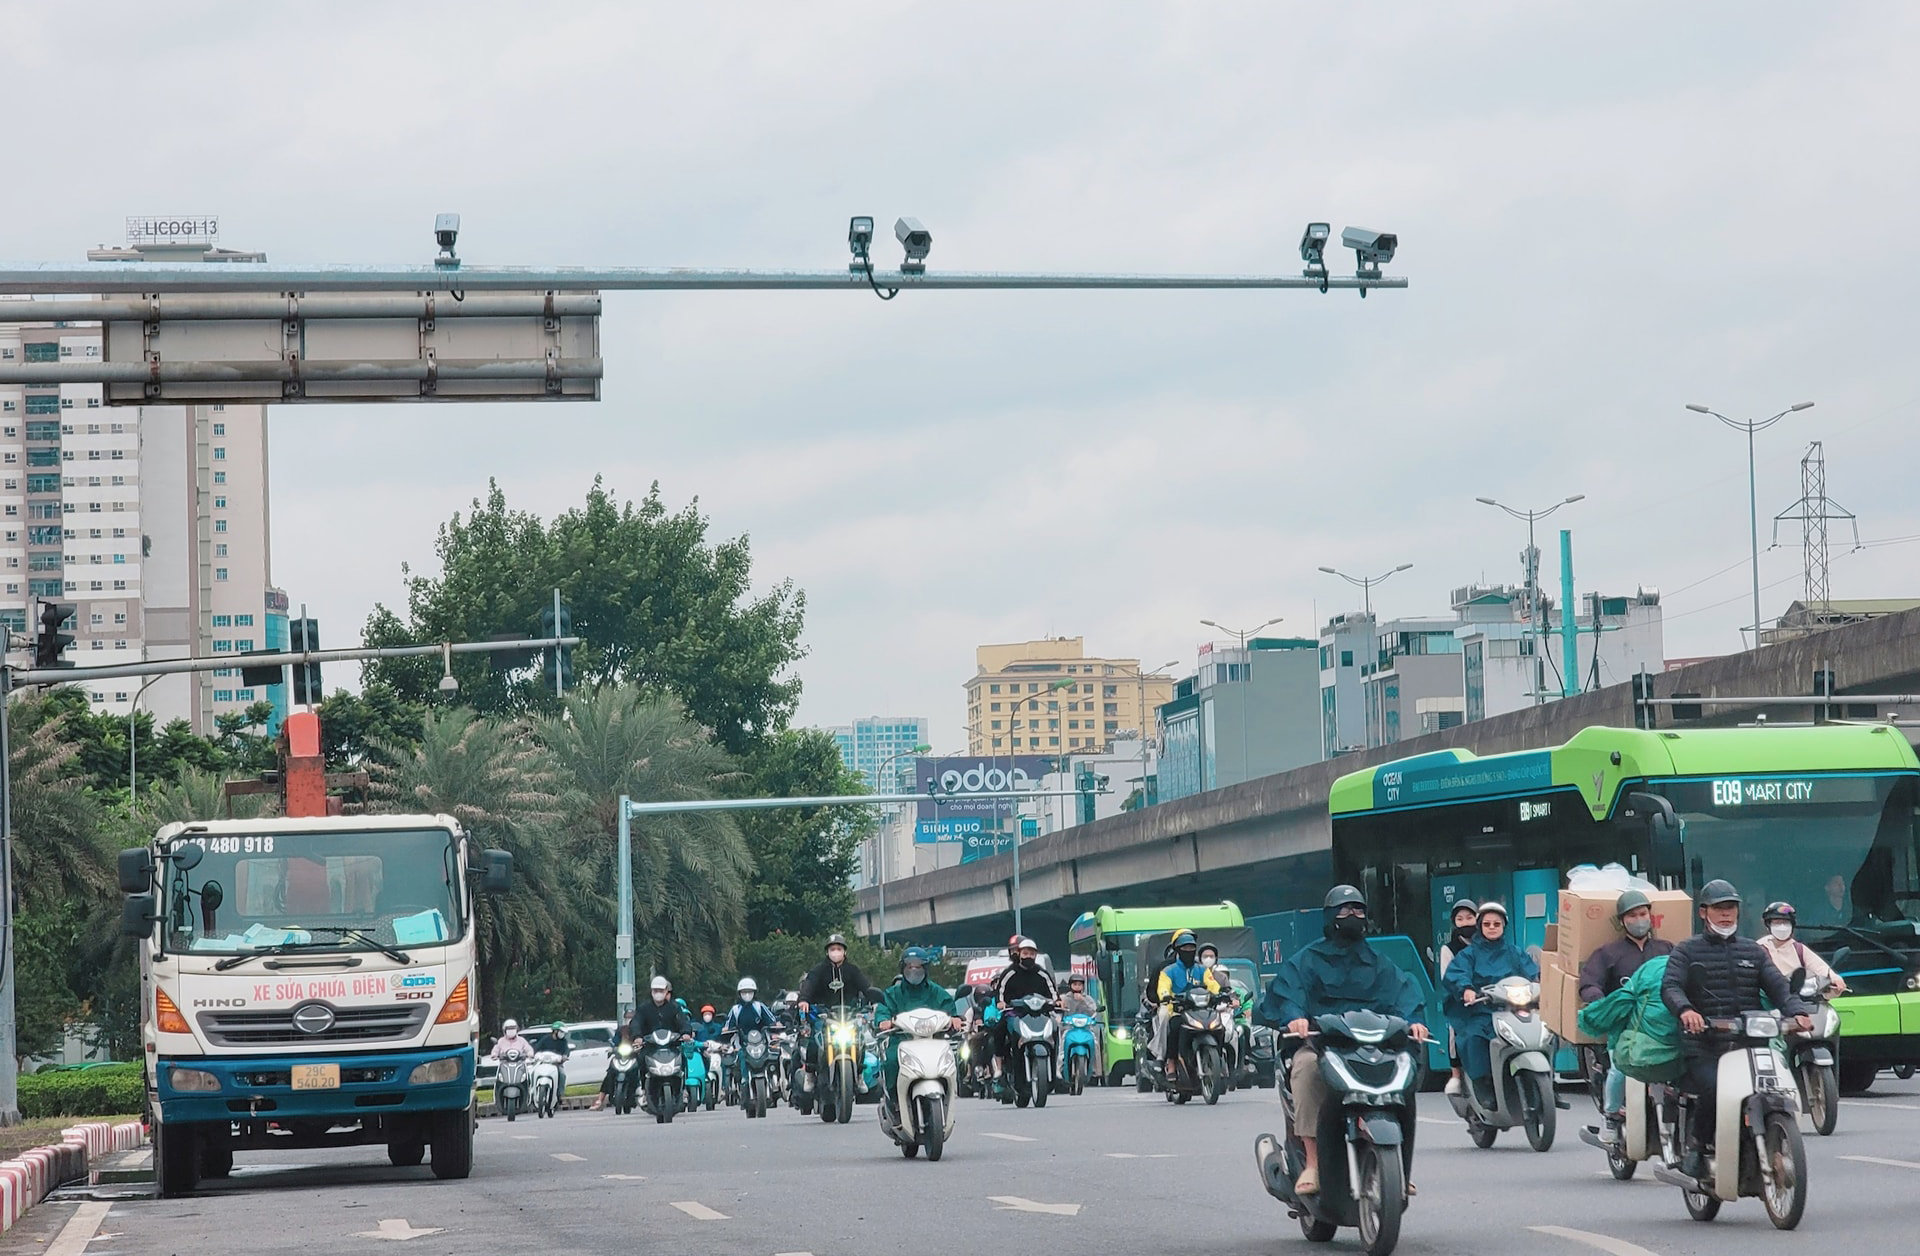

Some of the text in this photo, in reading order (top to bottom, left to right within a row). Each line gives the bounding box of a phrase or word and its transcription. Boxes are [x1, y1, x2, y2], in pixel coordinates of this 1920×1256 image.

[145, 220, 217, 235] LICOGI 13
[1383, 771, 1403, 786] OCEAN
[1387, 787, 1400, 801] CITY
[1713, 780, 1741, 805] E09
[1785, 782, 1812, 800] CITY
[210, 836, 240, 854] 480
[244, 836, 274, 853] 918
[253, 974, 387, 1001] XE SỬA CHỮA ĐIỆN
[402, 976, 436, 987] QDR
[193, 999, 246, 1007] HINO
[395, 992, 433, 1000] 500
[305, 1066, 326, 1077] 29C
[296, 1077, 336, 1088] 540.20
